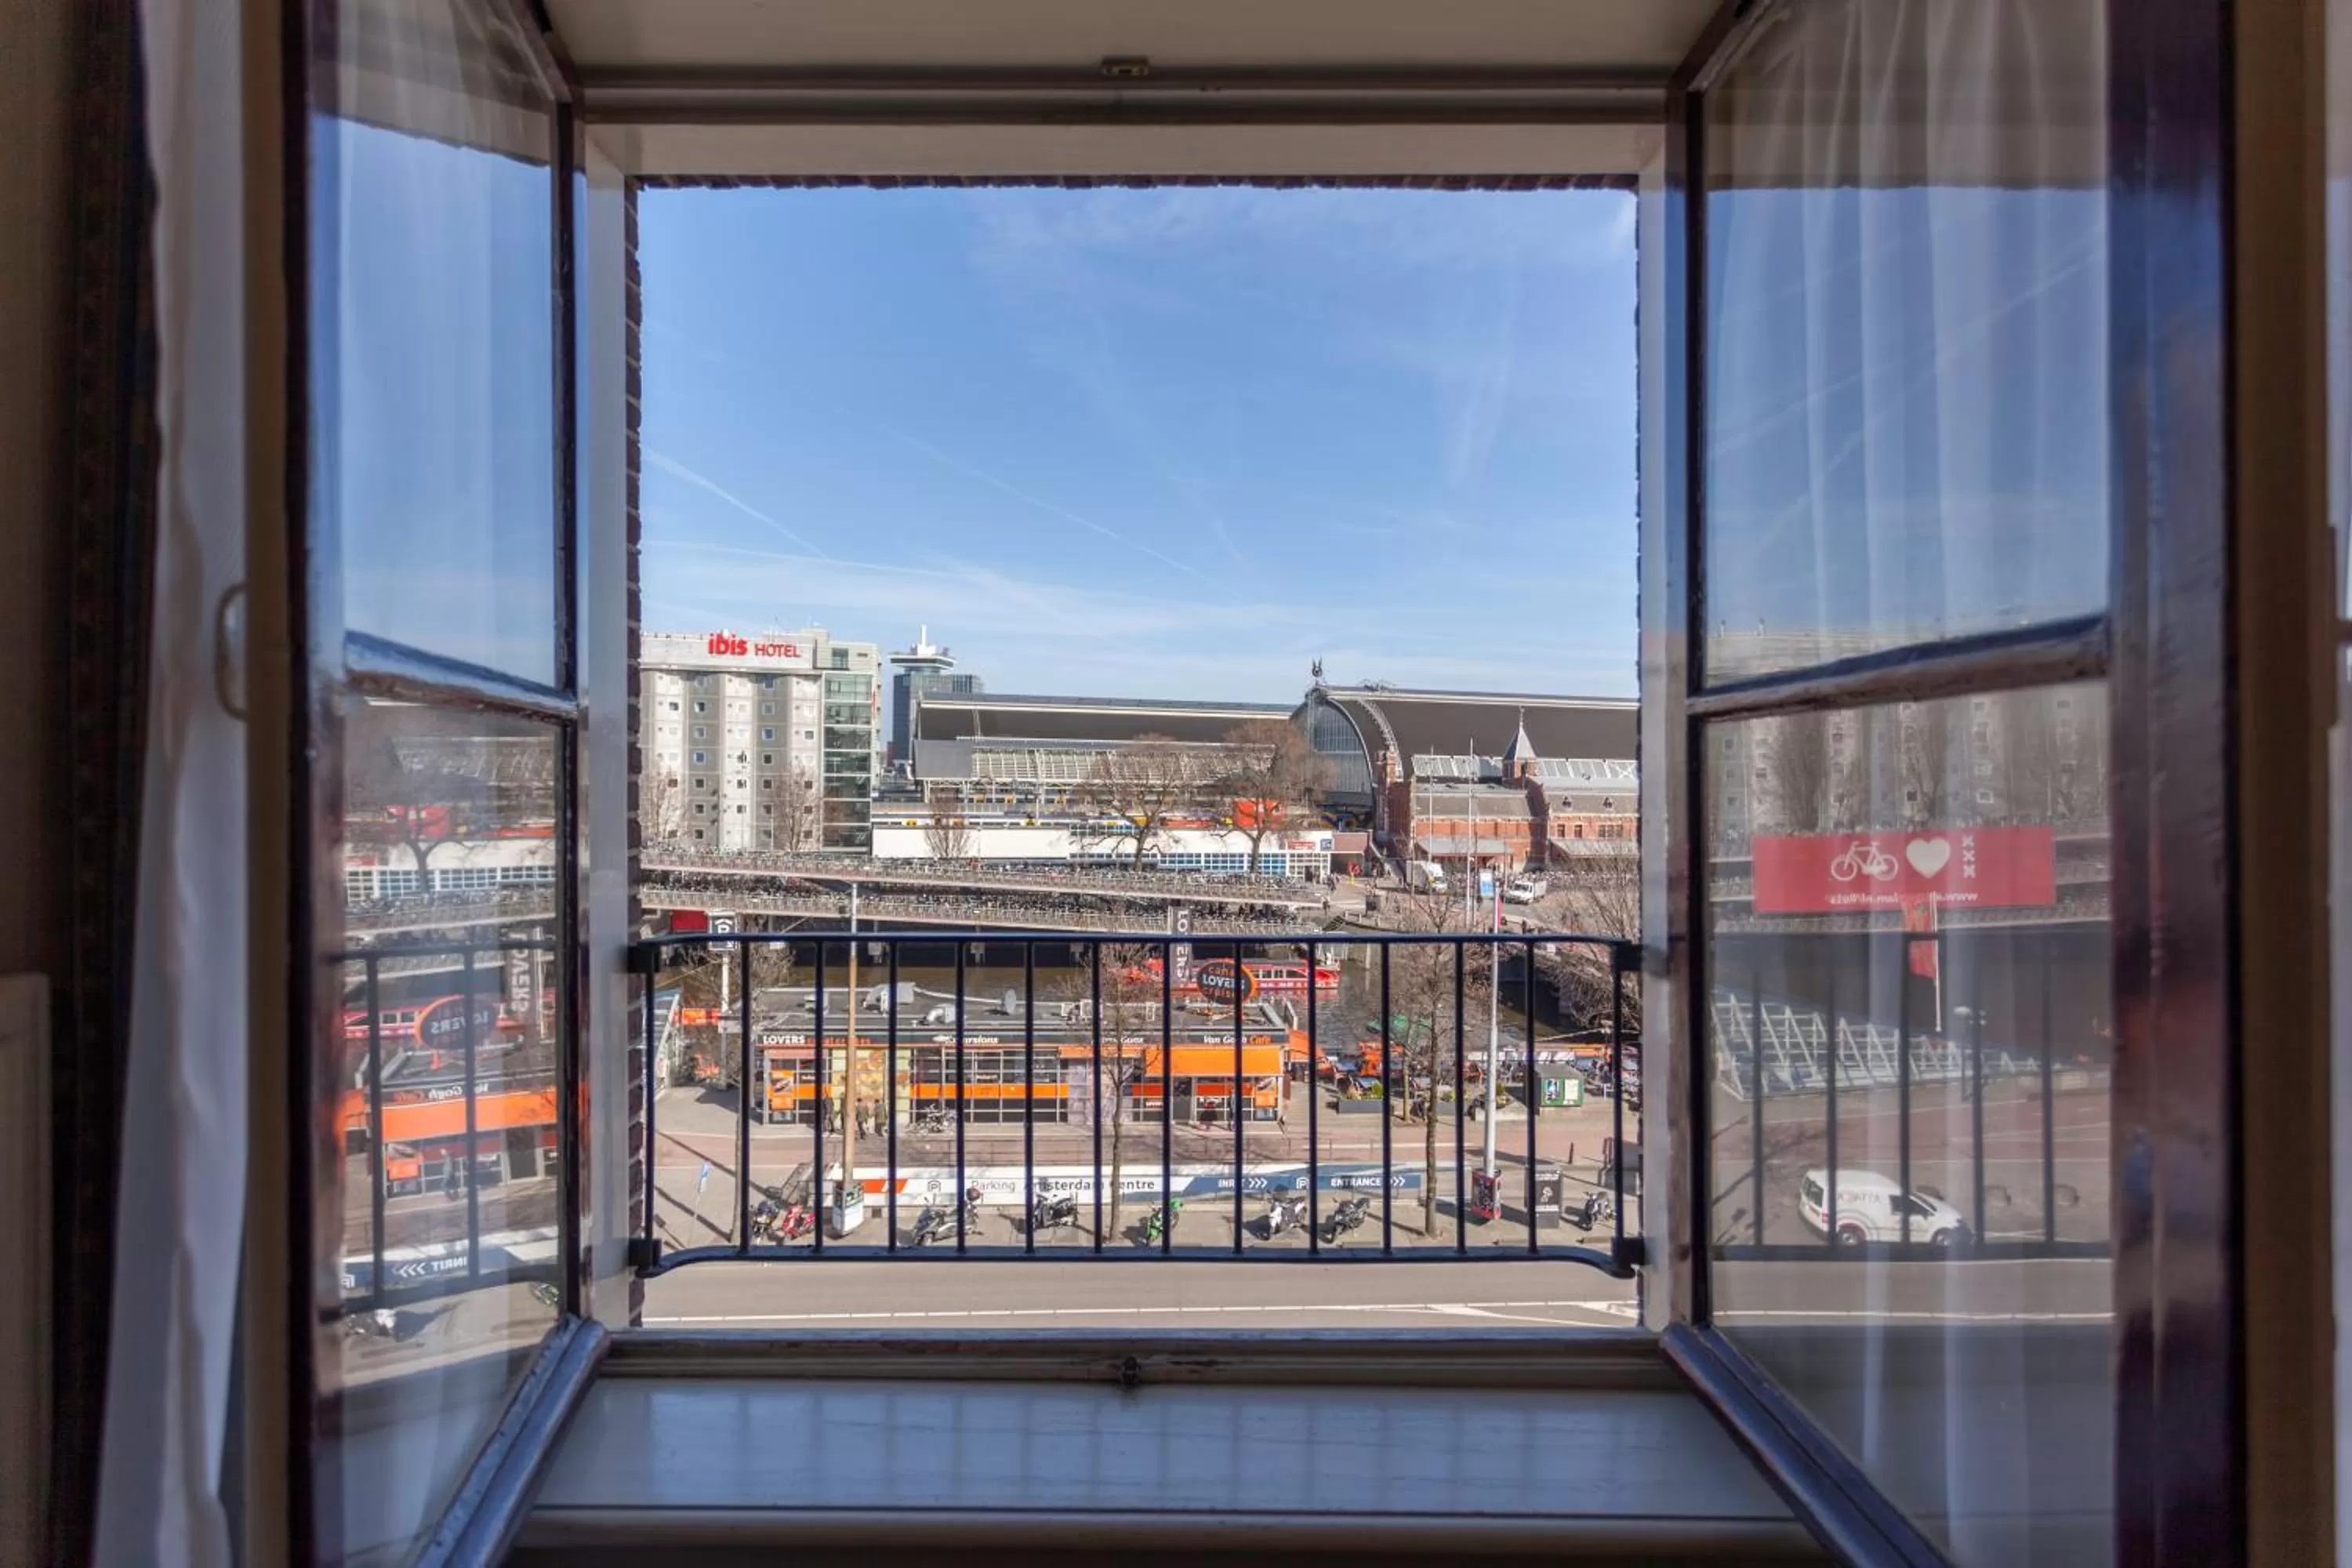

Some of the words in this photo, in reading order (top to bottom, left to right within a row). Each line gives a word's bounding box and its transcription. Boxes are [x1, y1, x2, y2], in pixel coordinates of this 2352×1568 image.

[708, 633, 748, 656] ibis
[755, 643, 802, 658] HOTEL
[1177, 909, 1189, 979] LOERS
[763, 1035, 805, 1044] LOVERS
[1203, 1035, 1221, 1044] Van
[1223, 1035, 1247, 1044] Goh
[972, 1181, 1016, 1192] Parking
[1025, 1178, 1104, 1191] msterda
[1110, 1179, 1155, 1191] entre
[1218, 1178, 1245, 1188] INRT
[1330, 1177, 1381, 1187] ENTRANCE
